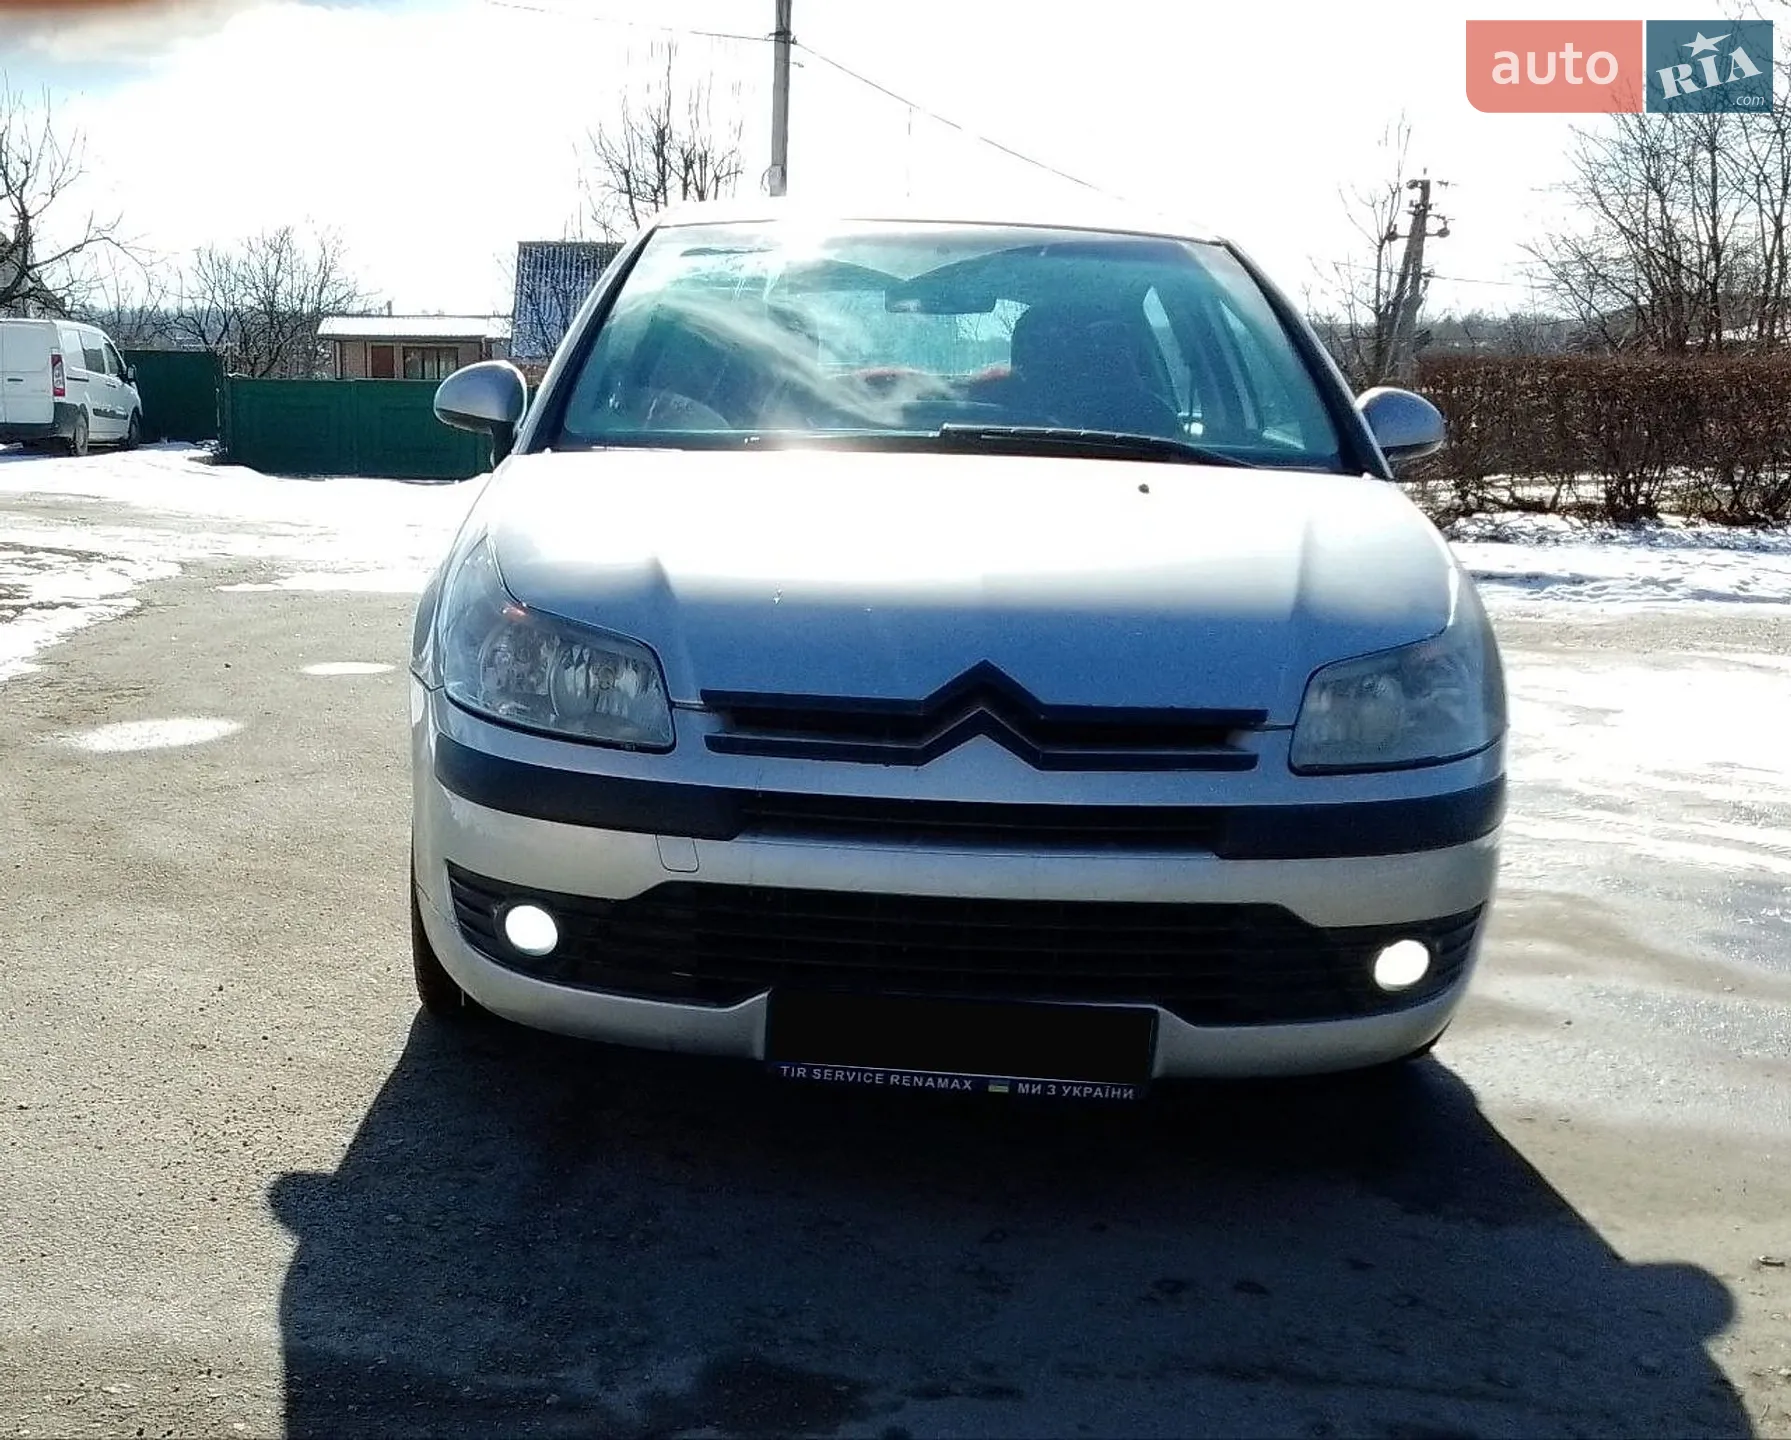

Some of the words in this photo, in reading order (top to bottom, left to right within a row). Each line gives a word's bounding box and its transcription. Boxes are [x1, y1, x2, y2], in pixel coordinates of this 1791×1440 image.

[780, 1065, 807, 1079] TIR
[812, 1068, 885, 1084] SERVICE
[889, 1074, 973, 1091] RENAMAX
[1017, 1082, 1042, 1095] МИ
[1060, 1084, 1135, 1100] УКРАЇНИ
